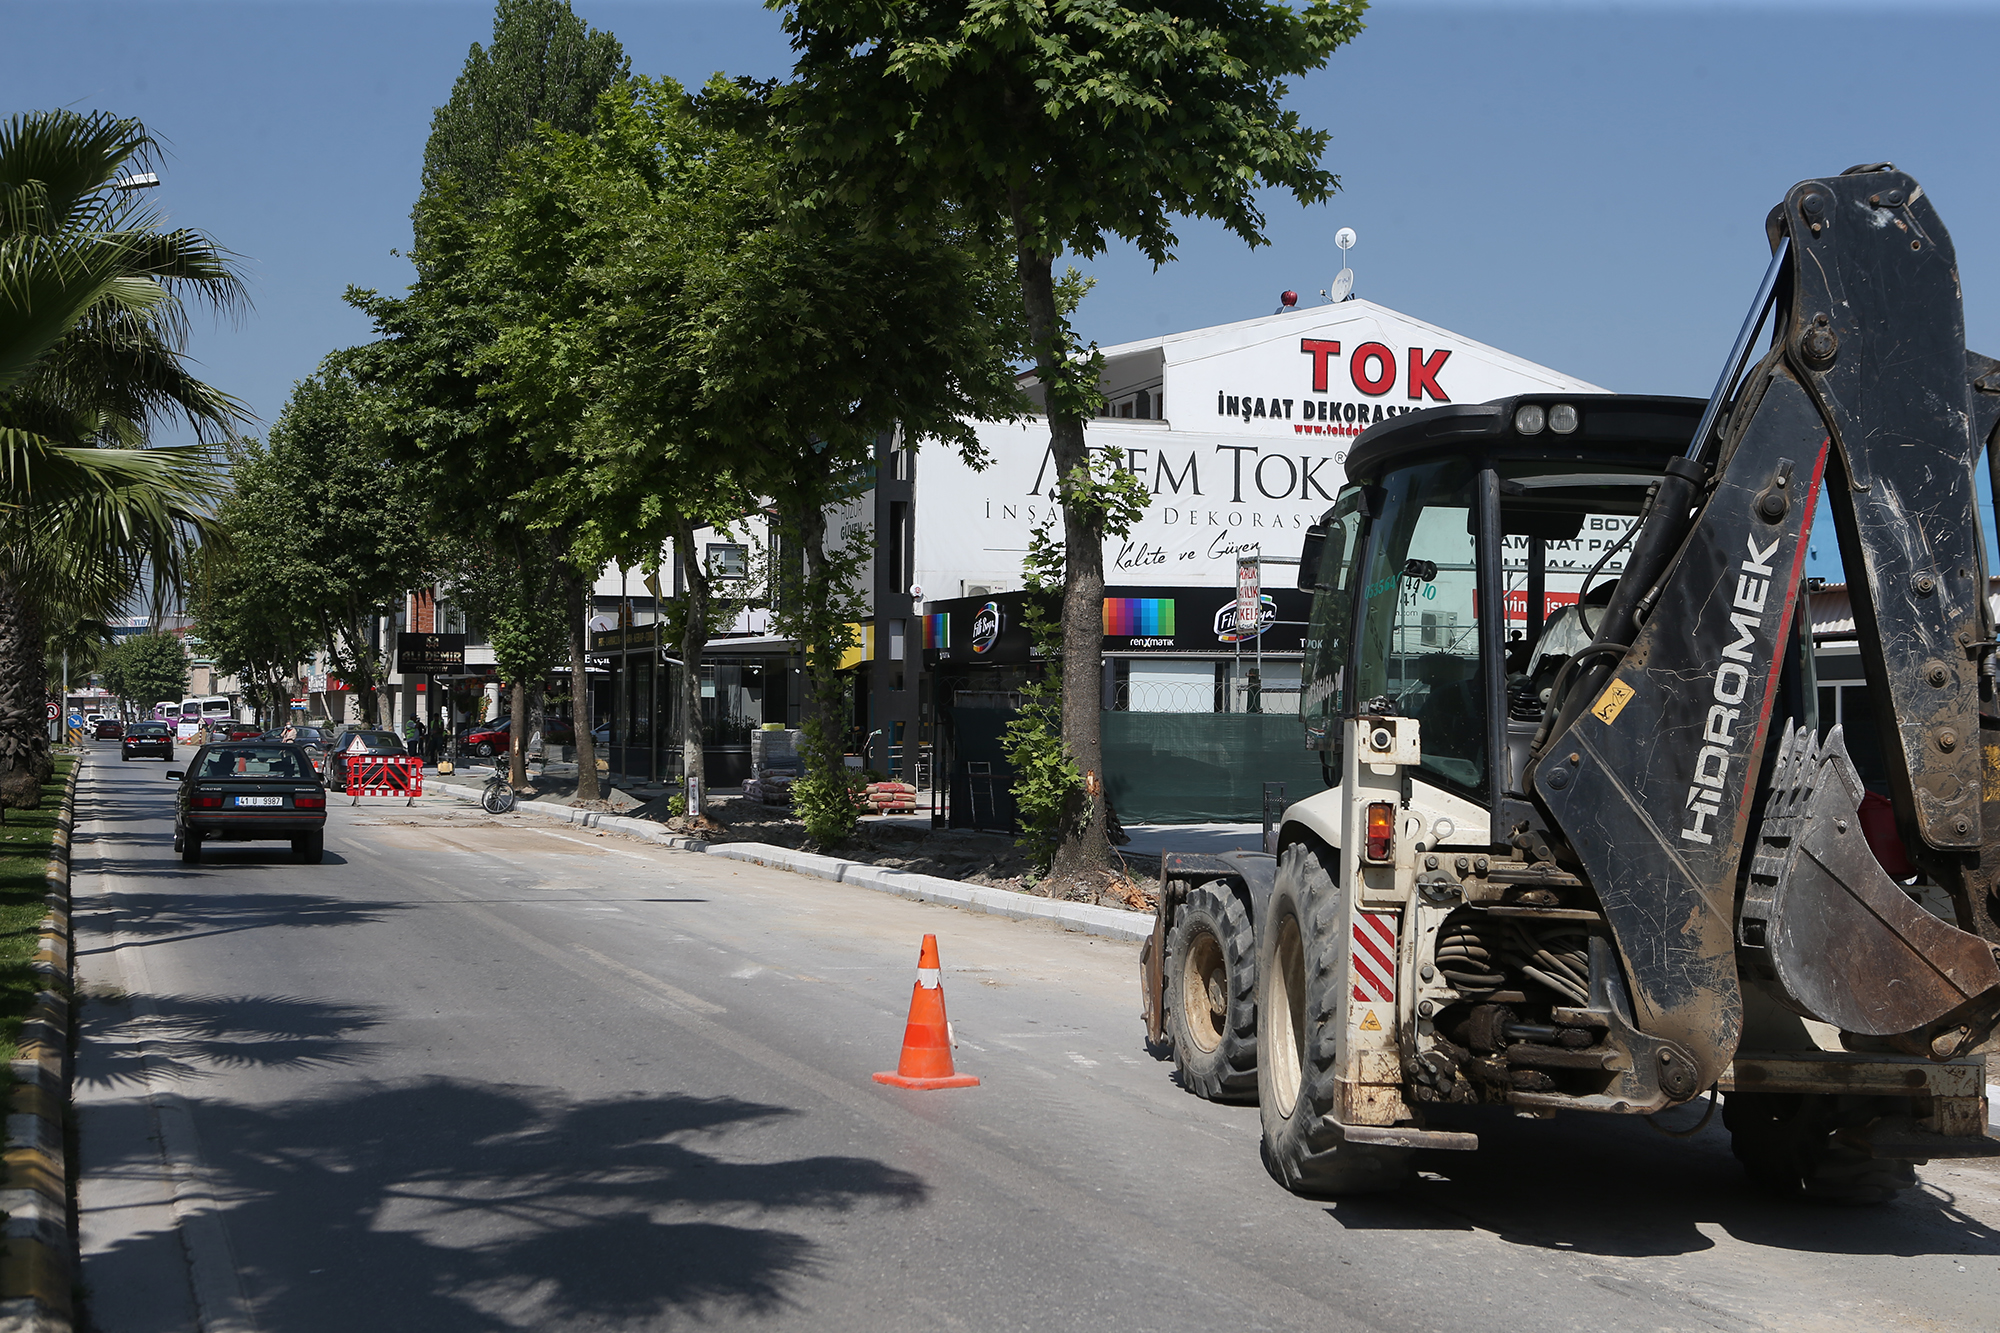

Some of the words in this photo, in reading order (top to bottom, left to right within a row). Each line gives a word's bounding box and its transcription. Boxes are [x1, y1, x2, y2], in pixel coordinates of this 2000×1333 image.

[1300, 338, 1453, 403] TOK
[1217, 390, 1294, 422] İNŞAAT
[985, 498, 1058, 525] İNŞA
[1112, 541, 1168, 573] Kalite
[1179, 550, 1197, 561] ve
[1207, 529, 1260, 560] Güven
[240, 797, 249, 806] 41
[252, 797, 258, 806] U
[263, 797, 280, 806] 9987
